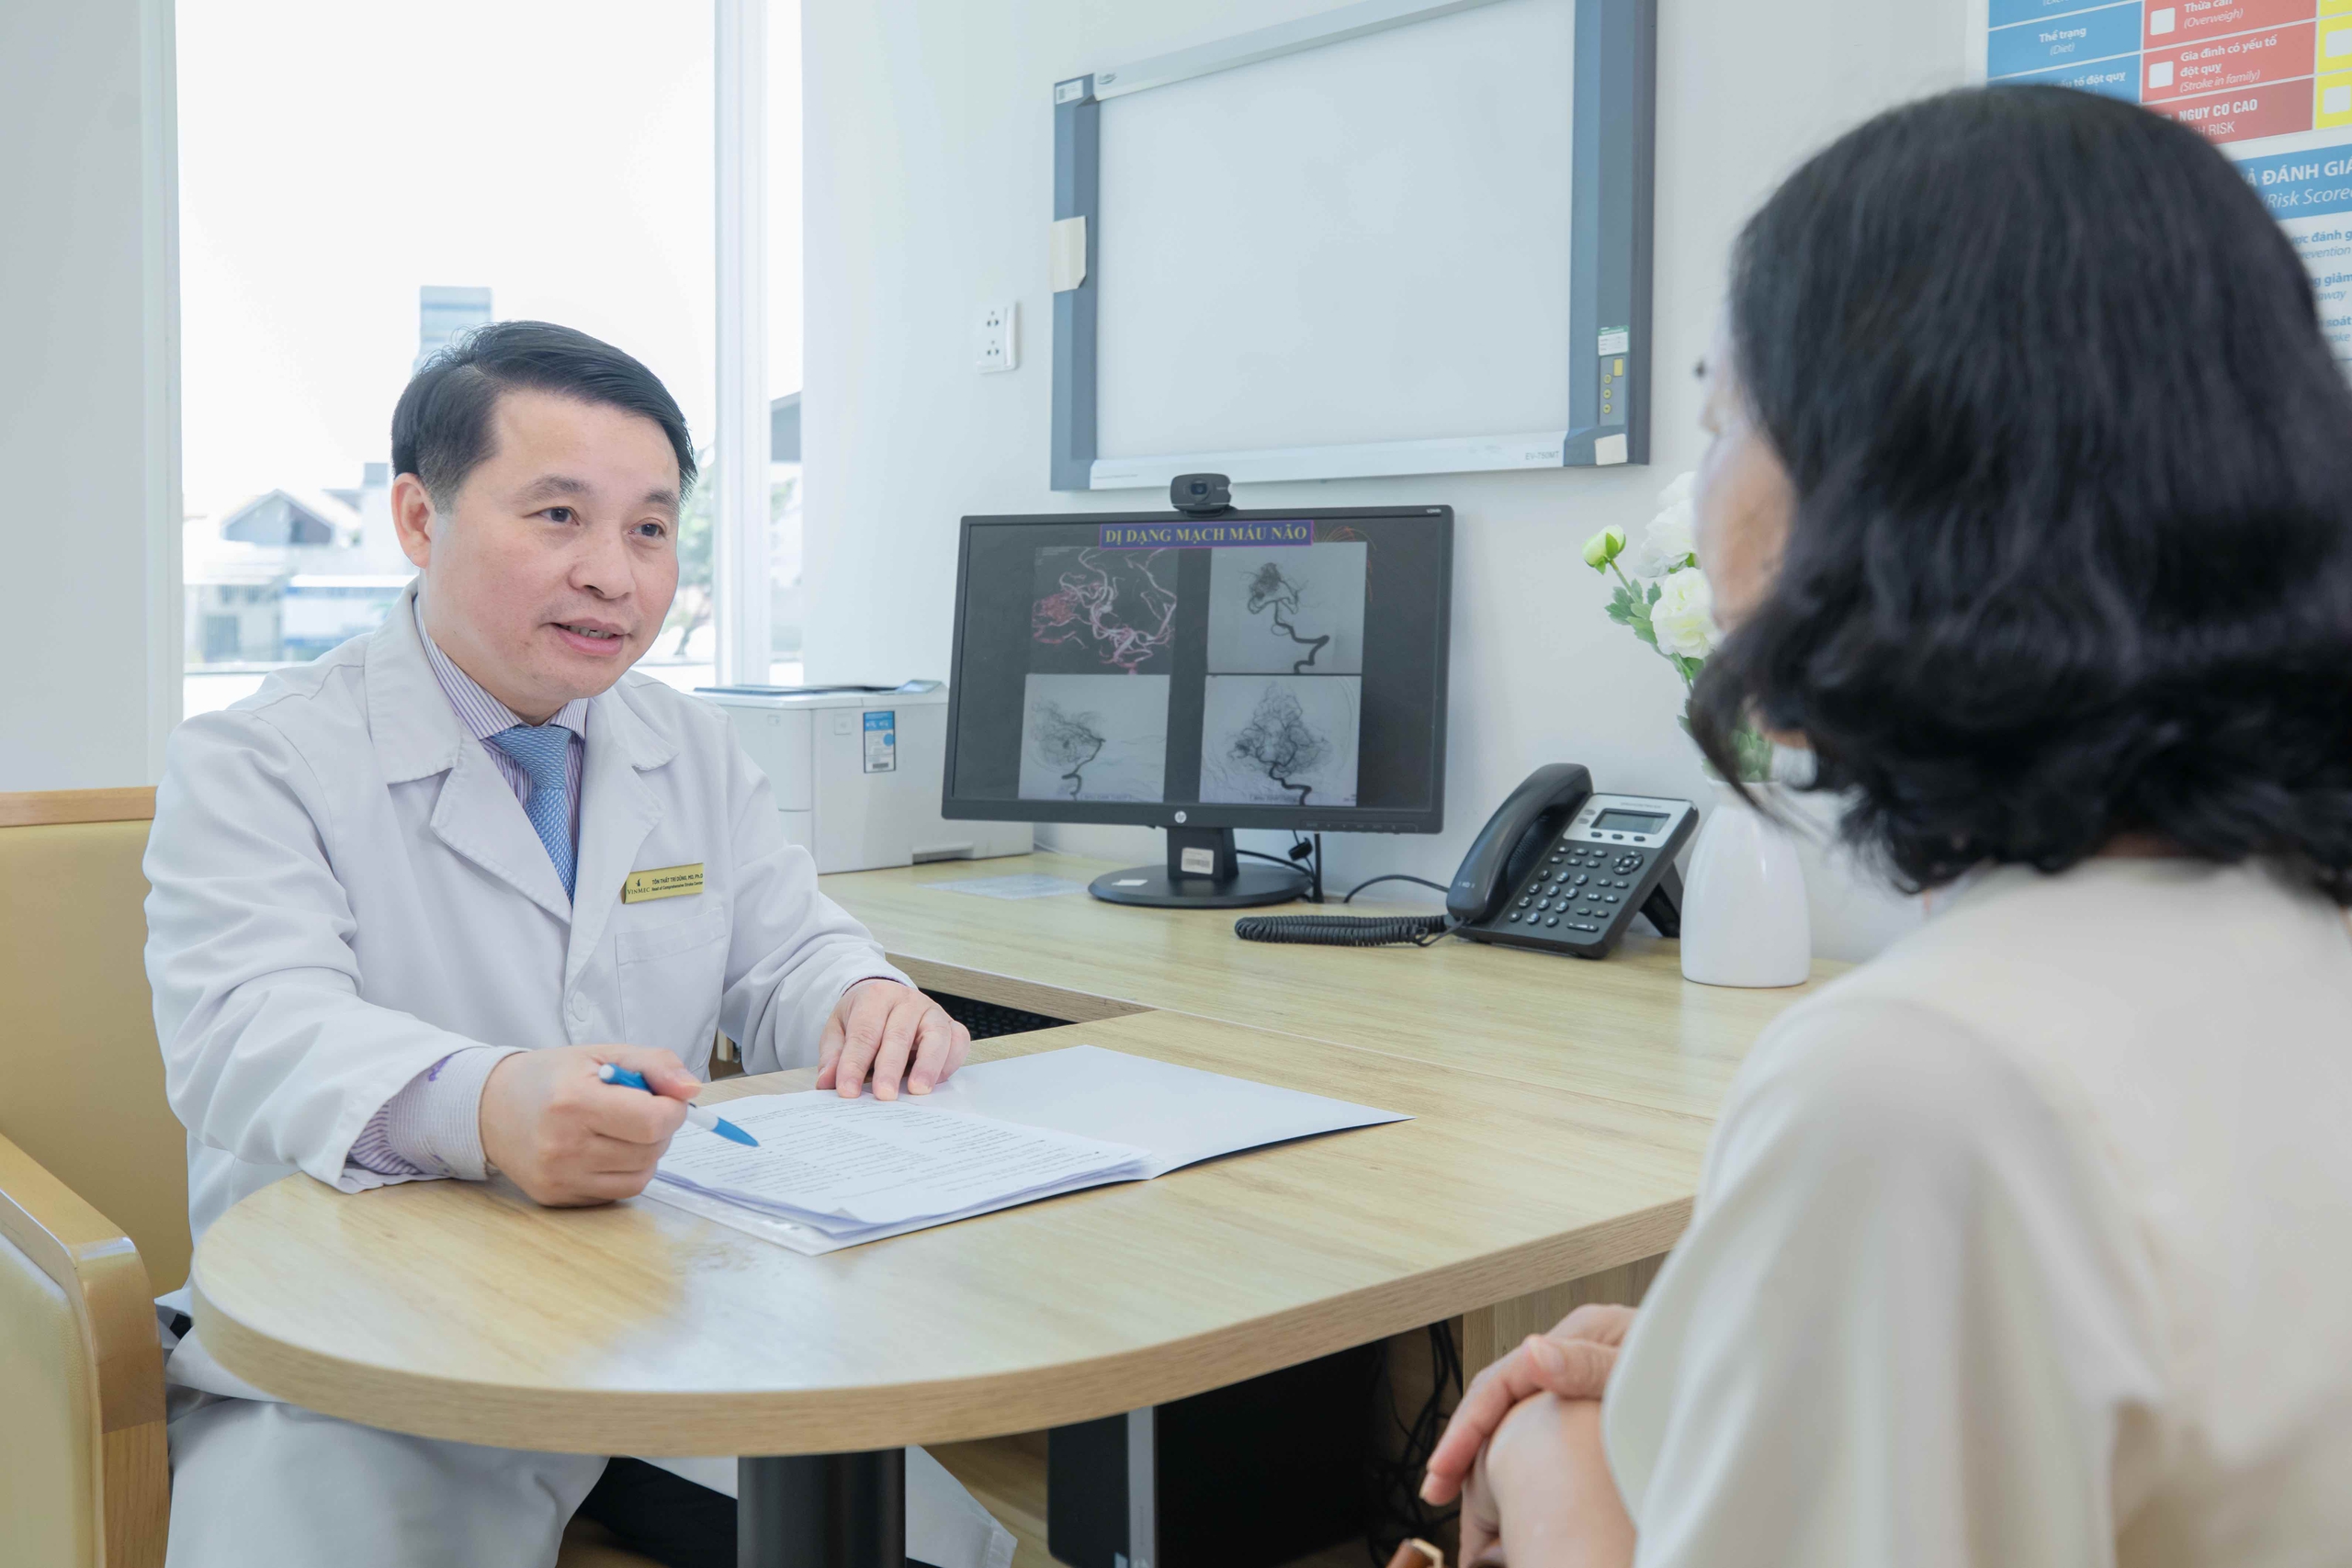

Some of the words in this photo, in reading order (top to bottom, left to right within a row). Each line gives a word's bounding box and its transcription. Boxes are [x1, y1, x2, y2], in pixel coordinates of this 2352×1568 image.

[2180, 51, 2199, 62] Gia
[2227, 42, 2240, 53] có
[2179, 78, 2213, 93] (Stroke
[2214, 76, 2224, 86] in
[2225, 69, 2261, 84] family)
[2178, 107, 2210, 121] NGUY
[2233, 98, 2258, 114] CAO
[2209, 121, 2235, 136] RISK
[2262, 164, 2319, 186] ĐÁNH
[2302, 187, 2352, 205] Score
[2312, 229, 2342, 243] đánh
[2300, 245, 2351, 260] revention
[1105, 529, 1122, 545] DỊ
[1126, 529, 1171, 545] DẠNG
[1176, 528, 1225, 544] MẠCH
[1229, 525, 1267, 540] MÁU
[1272, 525, 1306, 539] NÃO
